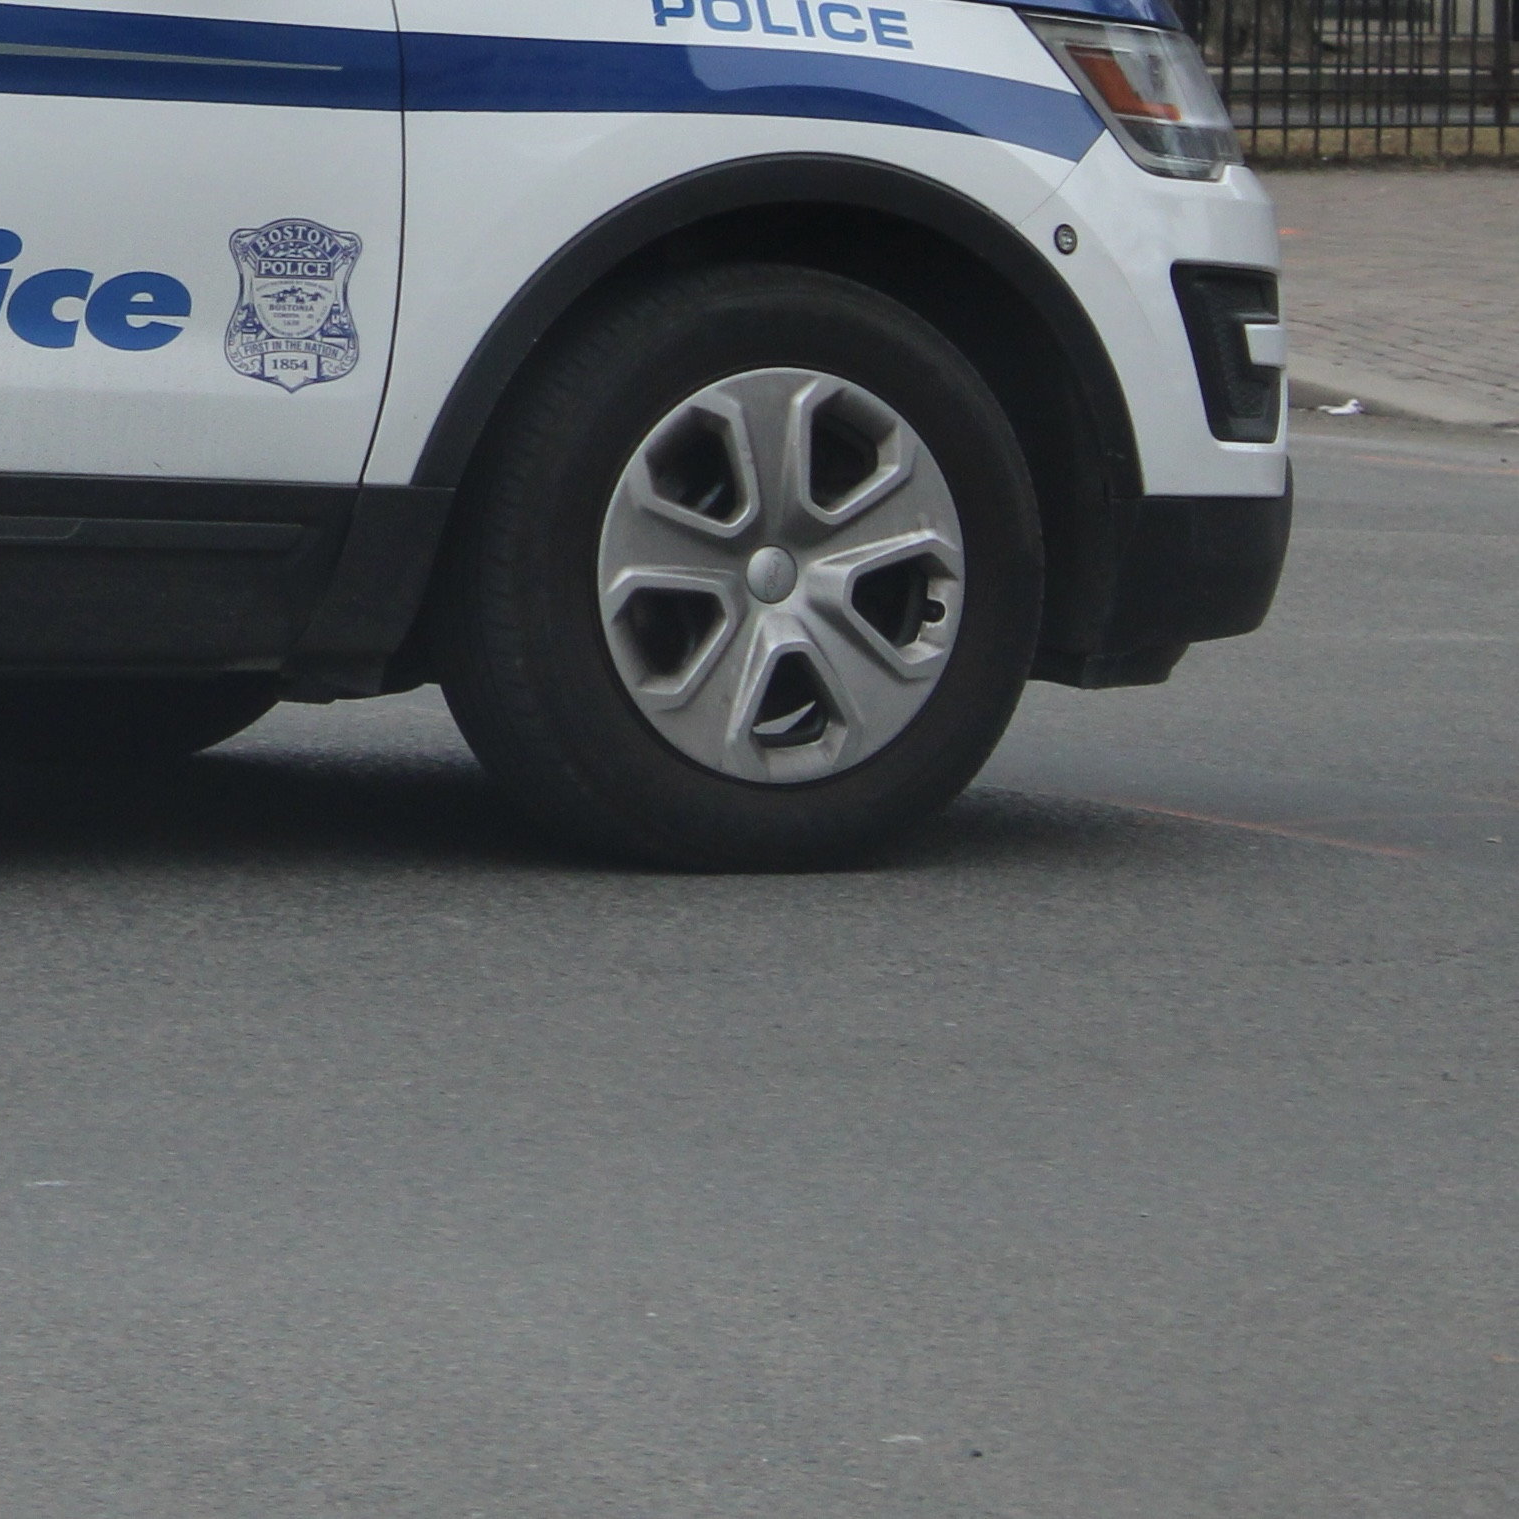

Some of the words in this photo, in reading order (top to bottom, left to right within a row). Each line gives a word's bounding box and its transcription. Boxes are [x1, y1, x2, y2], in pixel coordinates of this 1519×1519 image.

[256, 226, 335, 252] BOSTON
[260, 261, 328, 277] POLICE
[244, 340, 269, 355] FIRST
[272, 340, 281, 350] IN
[285, 340, 301, 350] THE
[304, 341, 339, 358] NATION
[272, 359, 309, 370] 1854
